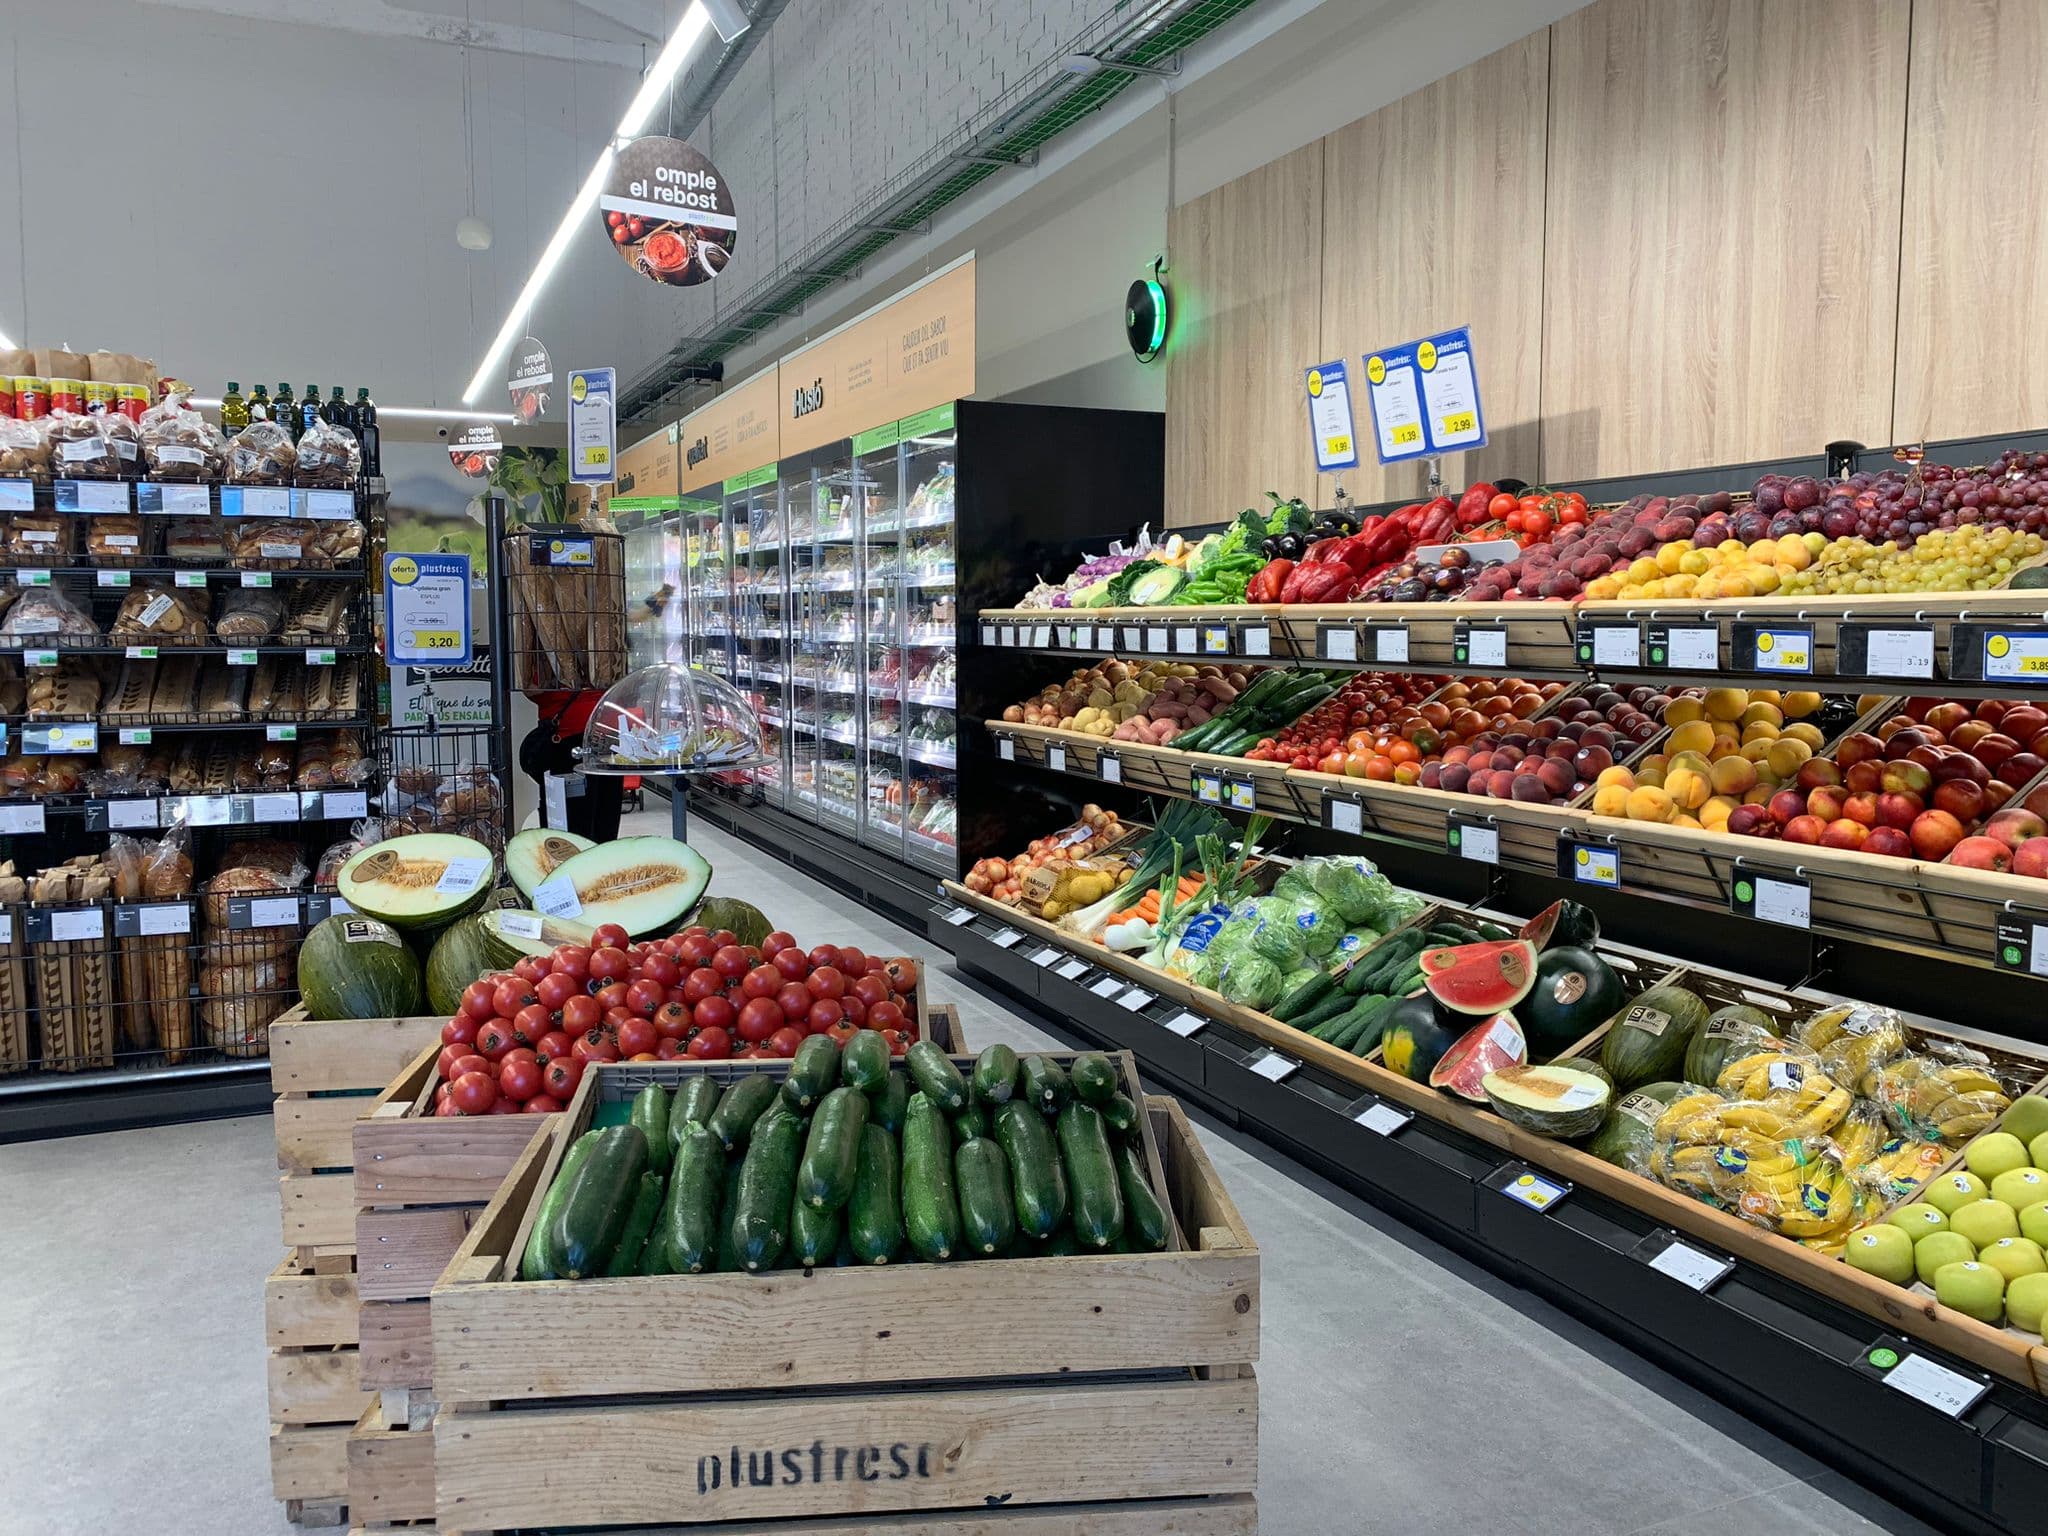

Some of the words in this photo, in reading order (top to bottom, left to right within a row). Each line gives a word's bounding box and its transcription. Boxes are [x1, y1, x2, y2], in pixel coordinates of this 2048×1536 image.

[655, 166, 717, 191] omple
[629, 179, 648, 198] el
[653, 185, 718, 210] rebost
[523, 351, 546, 365] omple
[516, 368, 523, 378] el
[523, 363, 547, 377] rebost
[468, 426, 494, 437] omple
[1453, 418, 1471, 433] 2,99
[458, 435, 467, 444] el
[468, 434, 495, 443] rebost
[1401, 430, 1416, 443] 1,39
[429, 637, 453, 649] 3,20
[1788, 655, 1804, 664] 2,49
[1906, 658, 1929, 666] 3.19
[409, 696, 423, 710] El
[462, 695, 475, 707] de
[404, 711, 425, 721] PAR
